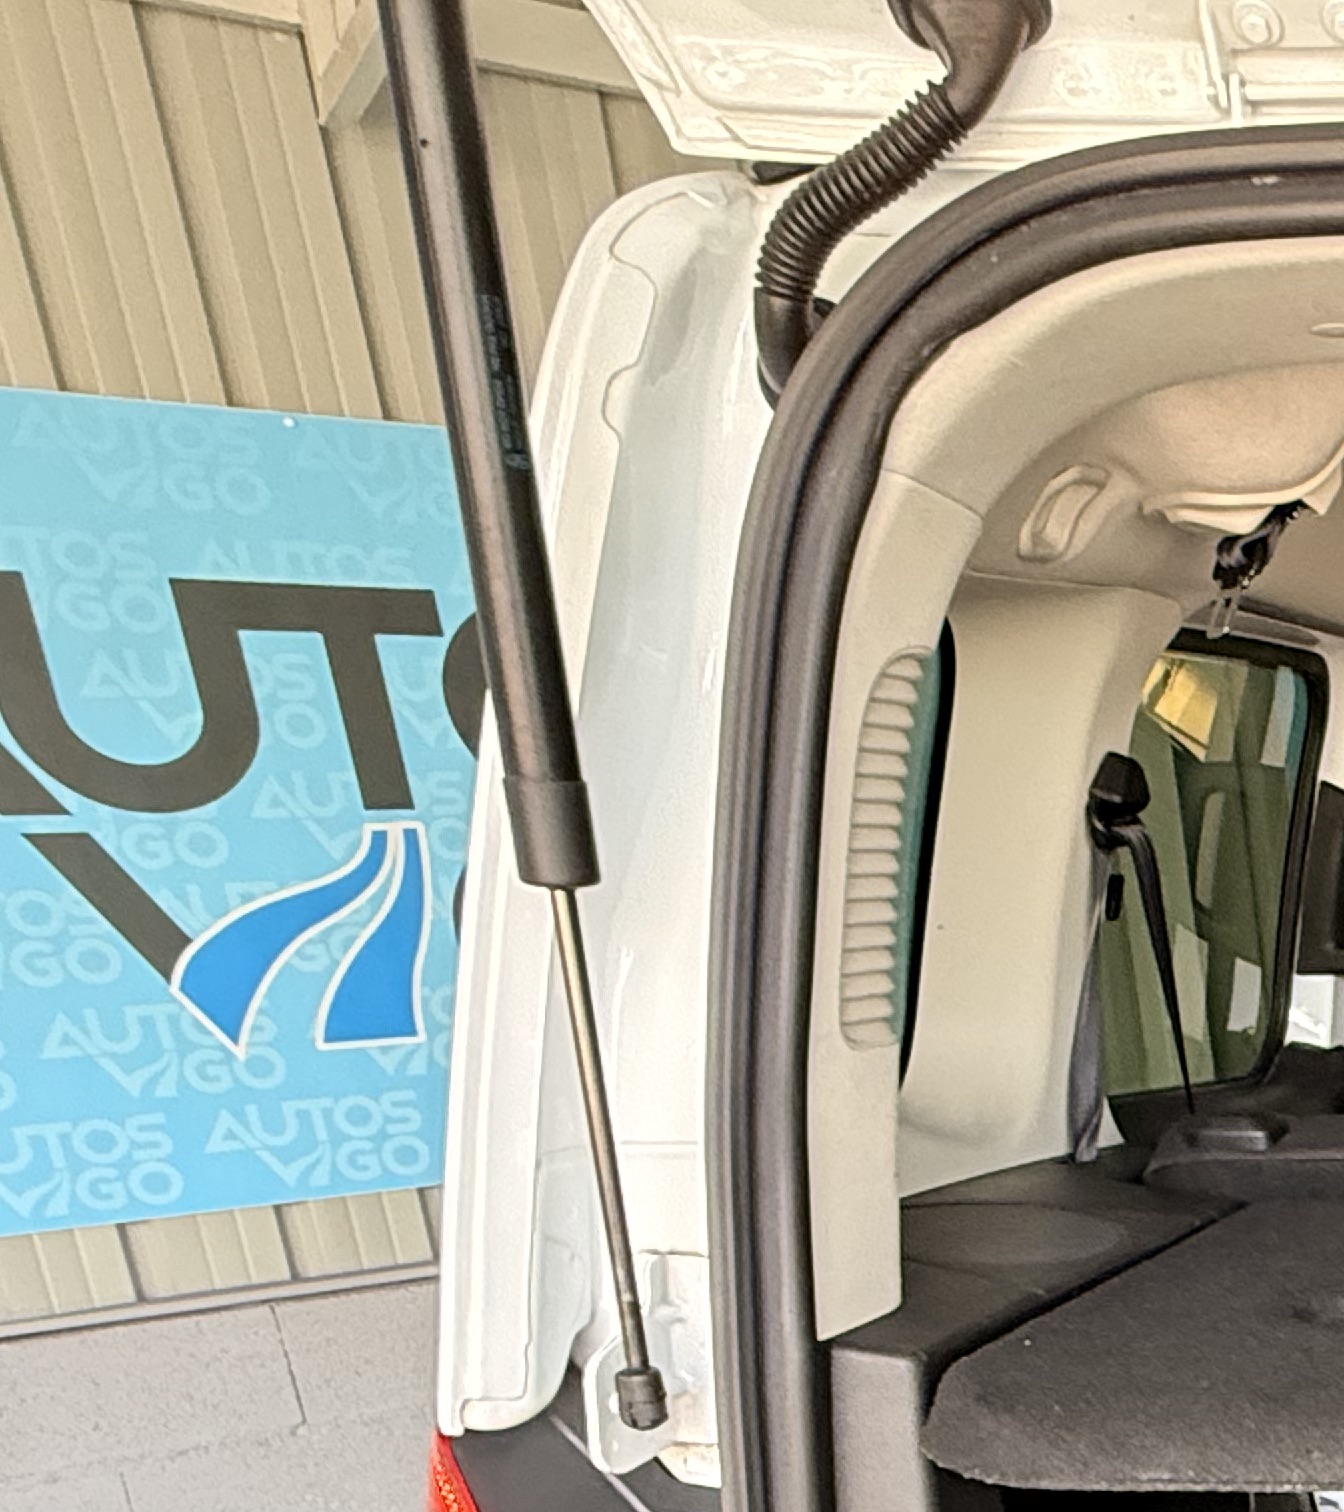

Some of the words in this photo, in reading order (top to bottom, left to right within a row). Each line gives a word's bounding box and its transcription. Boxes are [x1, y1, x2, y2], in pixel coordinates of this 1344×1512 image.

[11, 400, 261, 468] AUTOS
[0, 525, 158, 582] TOS
[40, 580, 170, 634] GO
[118, 819, 229, 870] GO
[8, 938, 123, 987] GO
[0, 1112, 174, 1174] UTOS
[204, 1090, 422, 1154] AUTOS
[255, 1134, 431, 1188] VIGO
